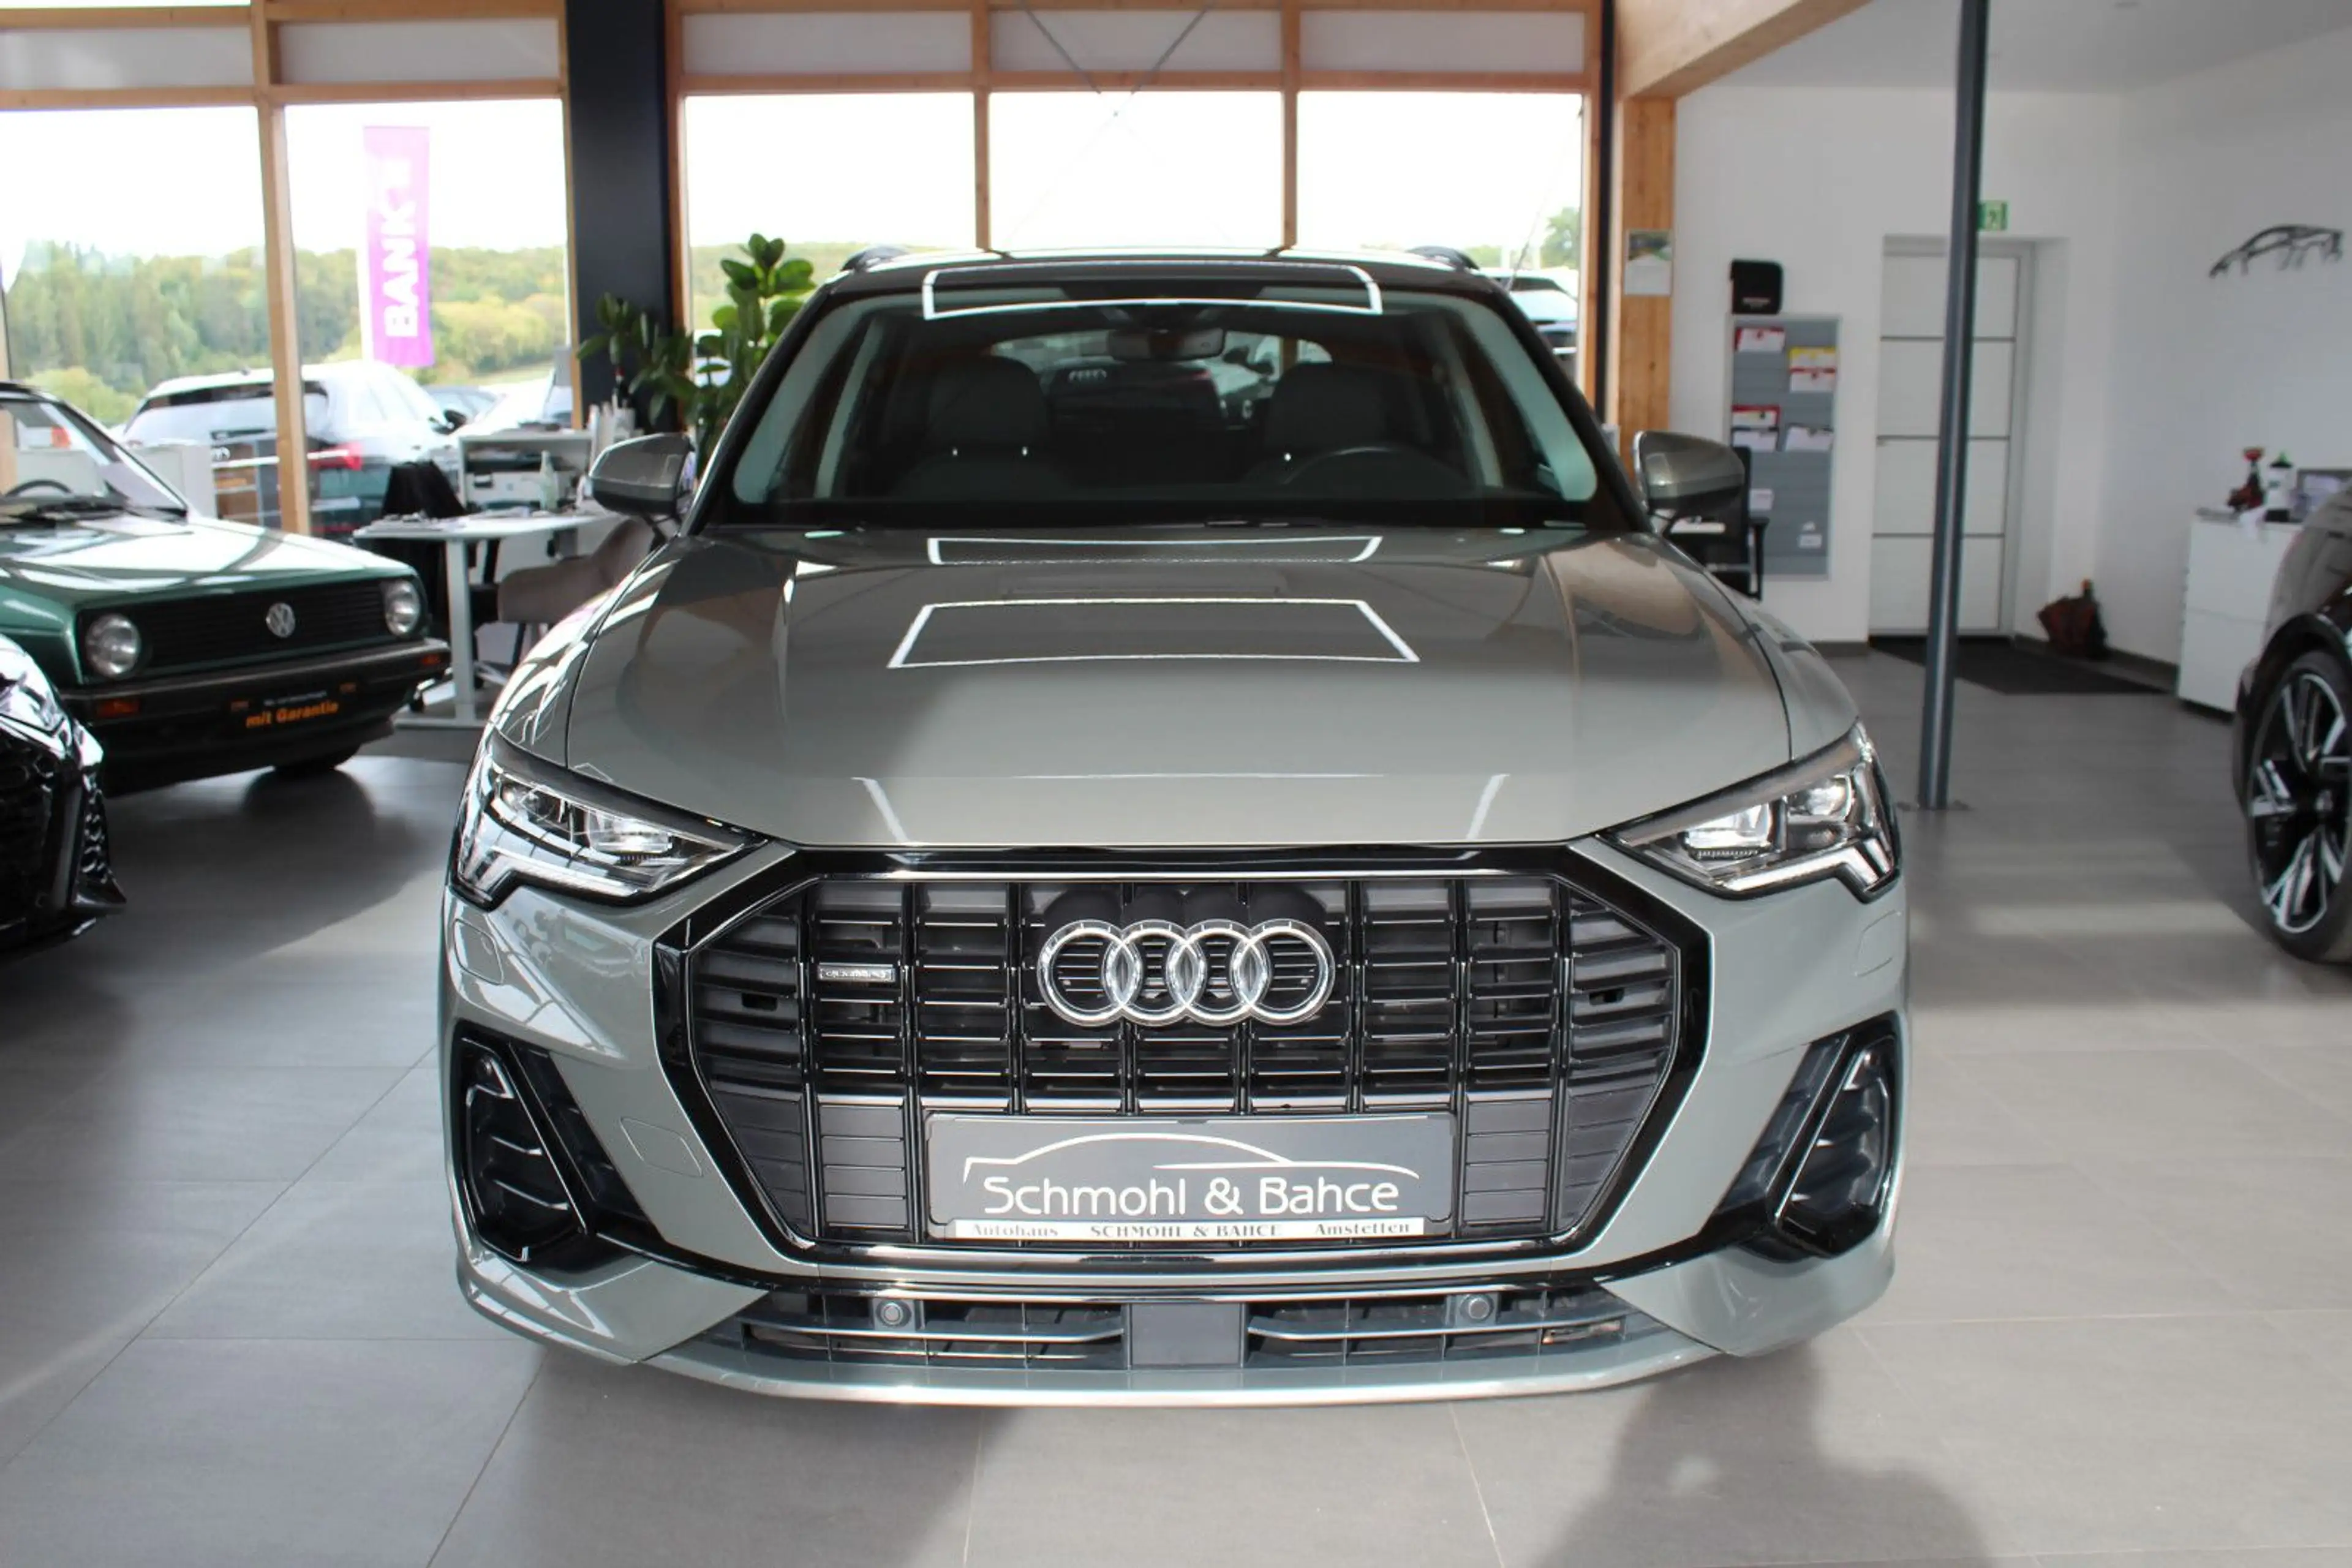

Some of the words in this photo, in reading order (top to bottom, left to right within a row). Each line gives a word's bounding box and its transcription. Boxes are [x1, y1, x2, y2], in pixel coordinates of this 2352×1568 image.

[983, 1177, 1186, 1215] Schmohl
[1204, 1177, 1244, 1215] &
[1259, 1176, 1399, 1214] Bahce
[972, 1225, 1058, 1237] Autohaus
[1090, 1225, 1182, 1238] SCHMOHL
[1193, 1224, 1210, 1237] &
[1314, 1222, 1411, 1235] Amstetten
